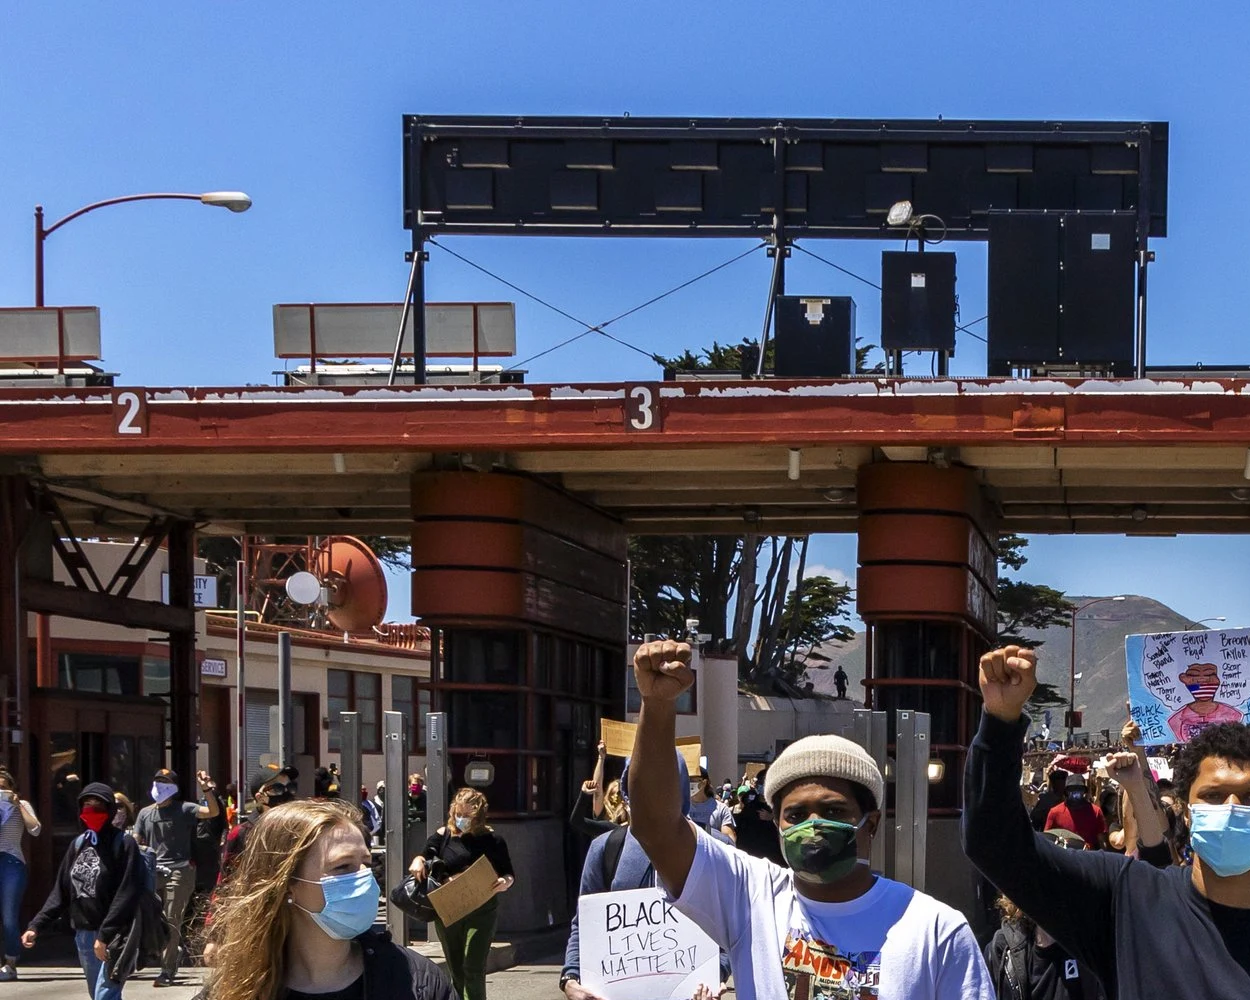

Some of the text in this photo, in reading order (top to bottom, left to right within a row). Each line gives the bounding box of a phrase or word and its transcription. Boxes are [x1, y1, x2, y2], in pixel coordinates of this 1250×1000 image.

[118, 391, 142, 434] 2
[630, 386, 653, 430] 3
[1182, 633, 1208, 649] George
[1135, 715, 1161, 728] IVES
[606, 899, 679, 932] BLACK
[608, 928, 679, 956] LIVES
